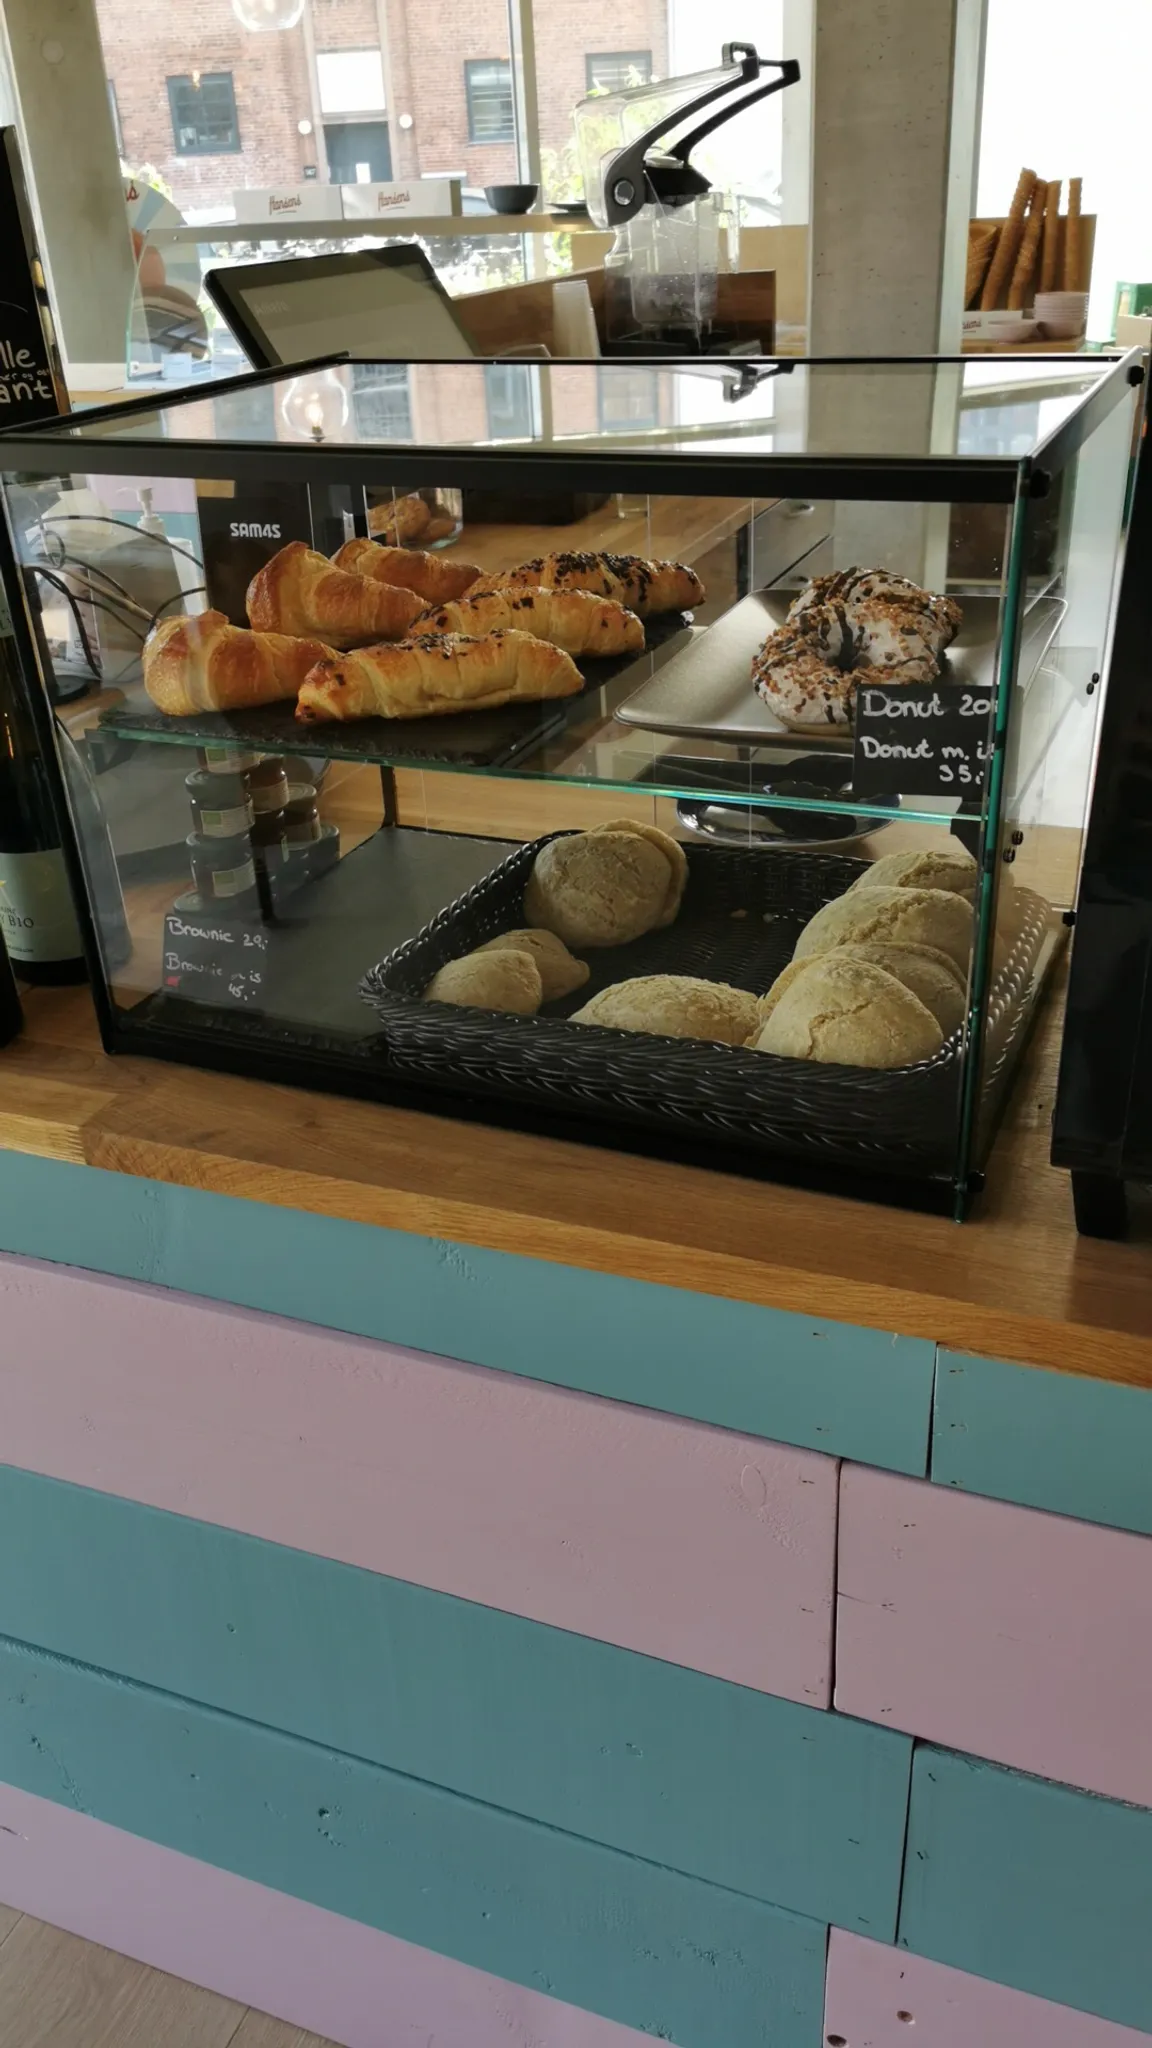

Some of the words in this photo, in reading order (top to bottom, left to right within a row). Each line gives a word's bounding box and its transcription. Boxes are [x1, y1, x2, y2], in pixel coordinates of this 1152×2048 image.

[229, 522, 282, 539] SAM4S
[861, 689, 945, 718] Donut
[859, 735, 934, 759] Donut
[941, 746, 970, 761] m.
[166, 916, 235, 943] Brownie
[165, 952, 223, 976] Browie
